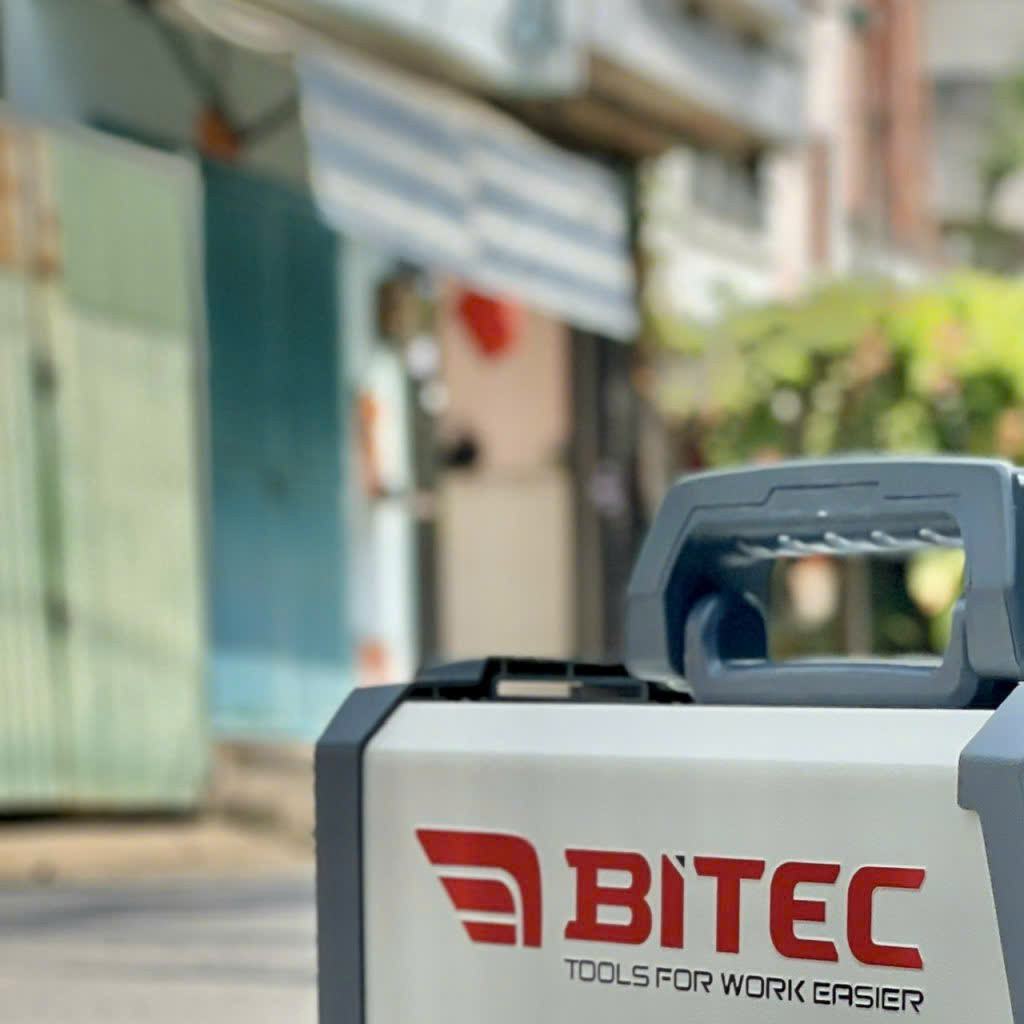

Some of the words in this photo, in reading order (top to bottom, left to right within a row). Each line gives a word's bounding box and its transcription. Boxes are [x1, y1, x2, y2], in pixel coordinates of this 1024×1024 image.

[563, 847, 927, 971] BITEC
[563, 958, 650, 988] TOOLS
[655, 966, 714, 994] FOR
[720, 972, 806, 1003] WORK
[812, 981, 925, 1014] EASIER
